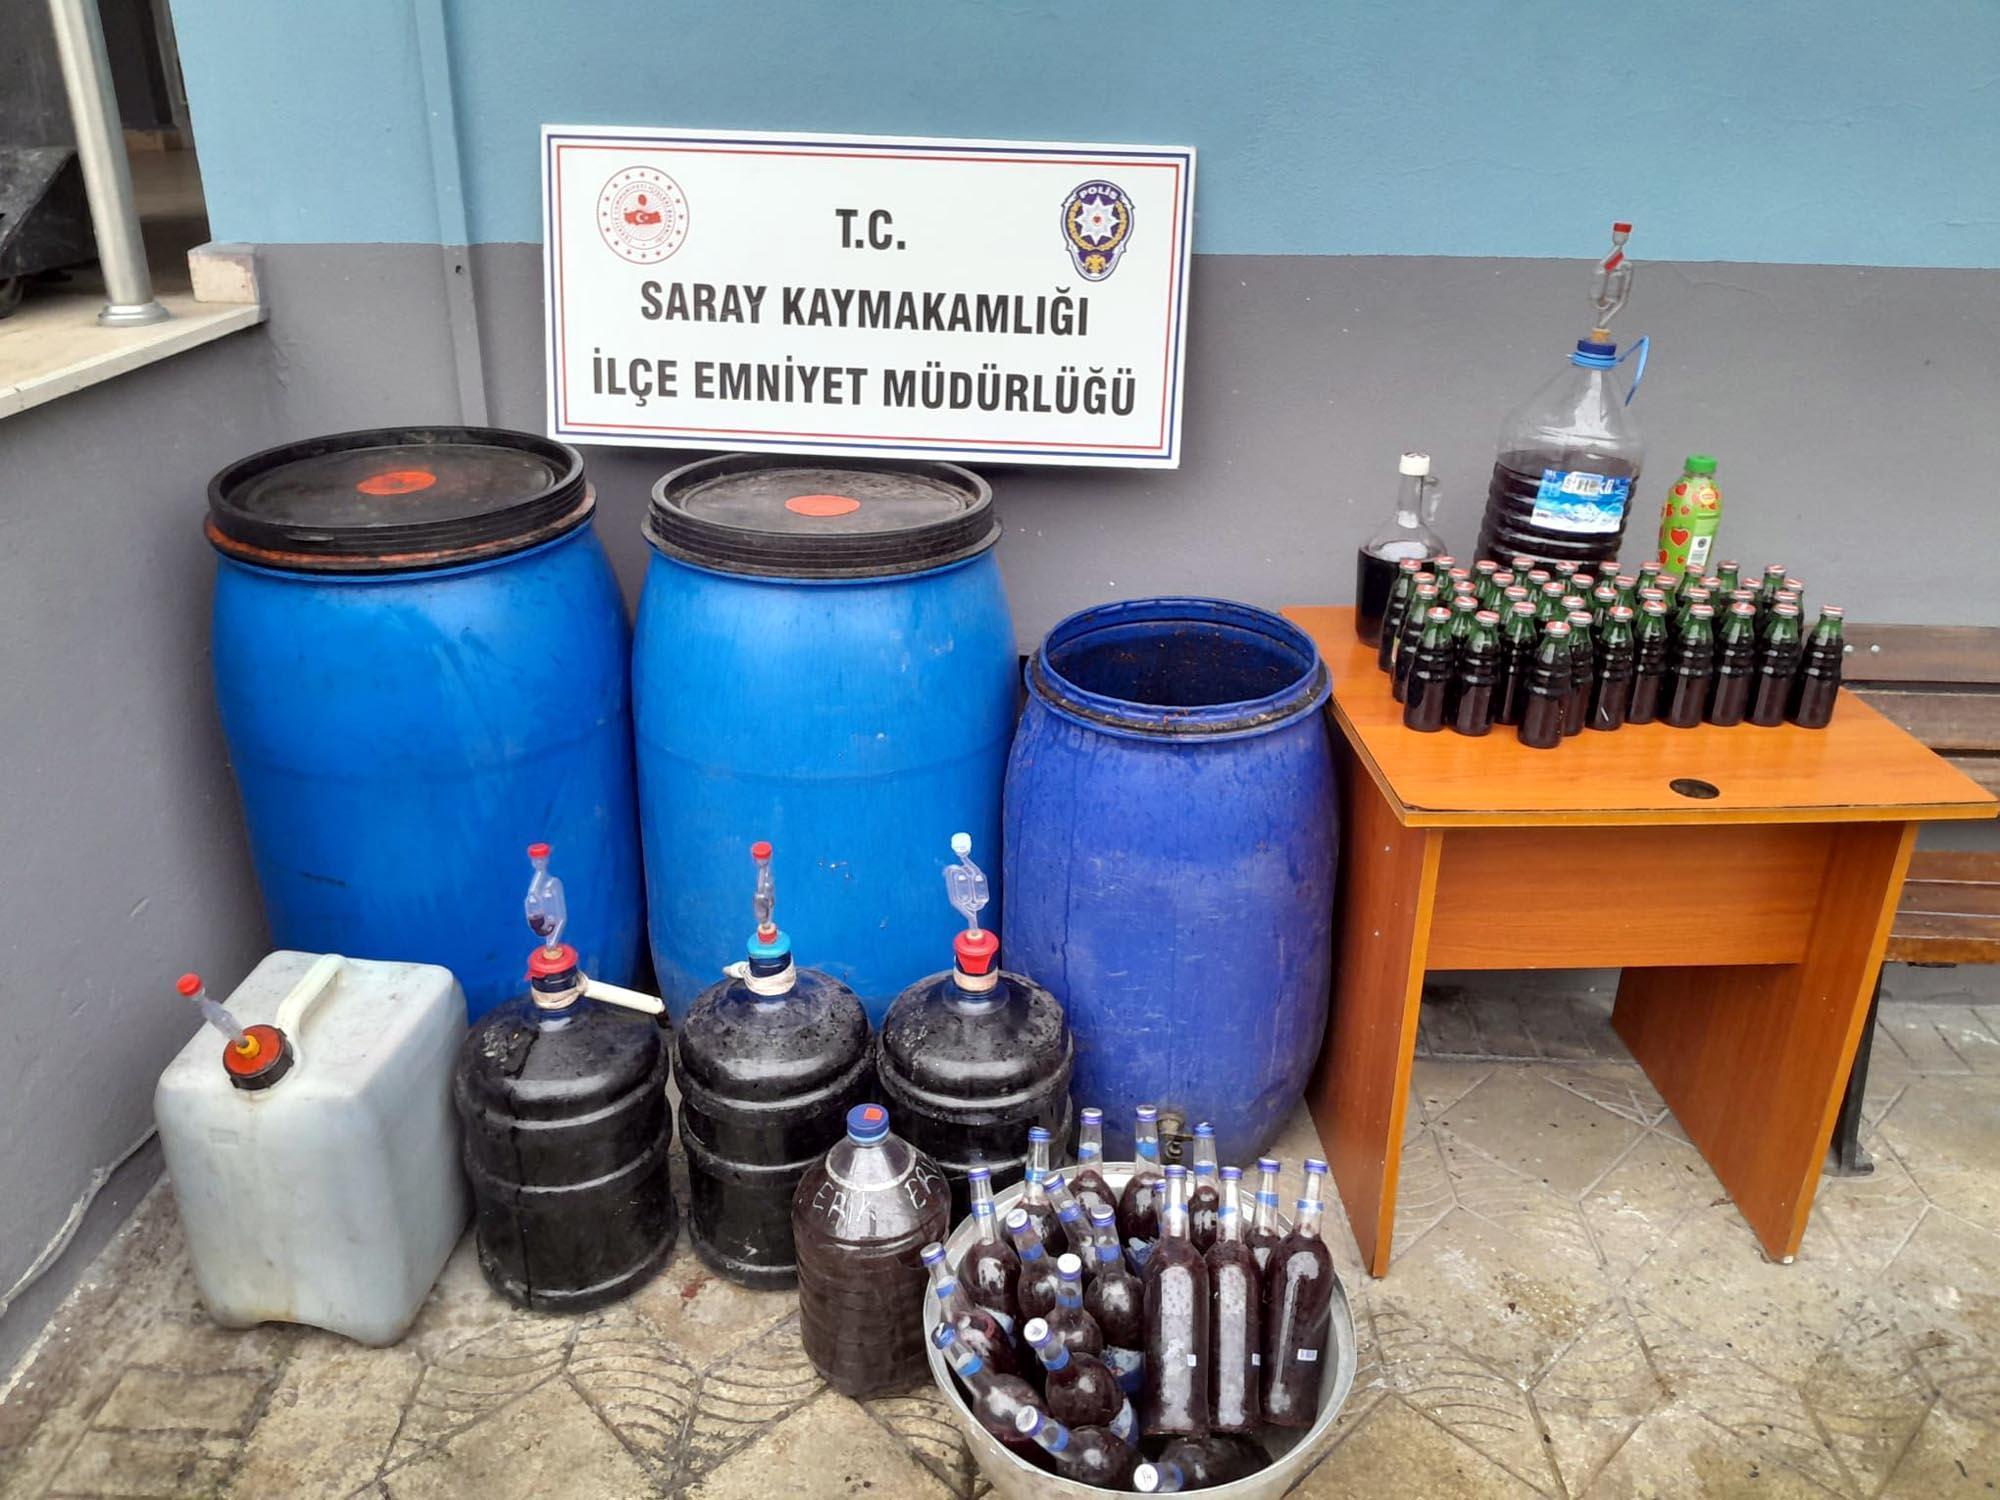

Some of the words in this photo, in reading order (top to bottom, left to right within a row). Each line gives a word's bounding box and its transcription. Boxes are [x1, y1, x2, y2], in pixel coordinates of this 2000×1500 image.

[836, 208, 906, 250] T.C.
[640, 280, 767, 324] SARAY
[783, 287, 1088, 336] KAYMAKAMLIĞI
[593, 347, 677, 407] İLÇE
[695, 355, 868, 405] EMNİYET
[883, 361, 1135, 416] MÜDÜRLÜĞÜ
